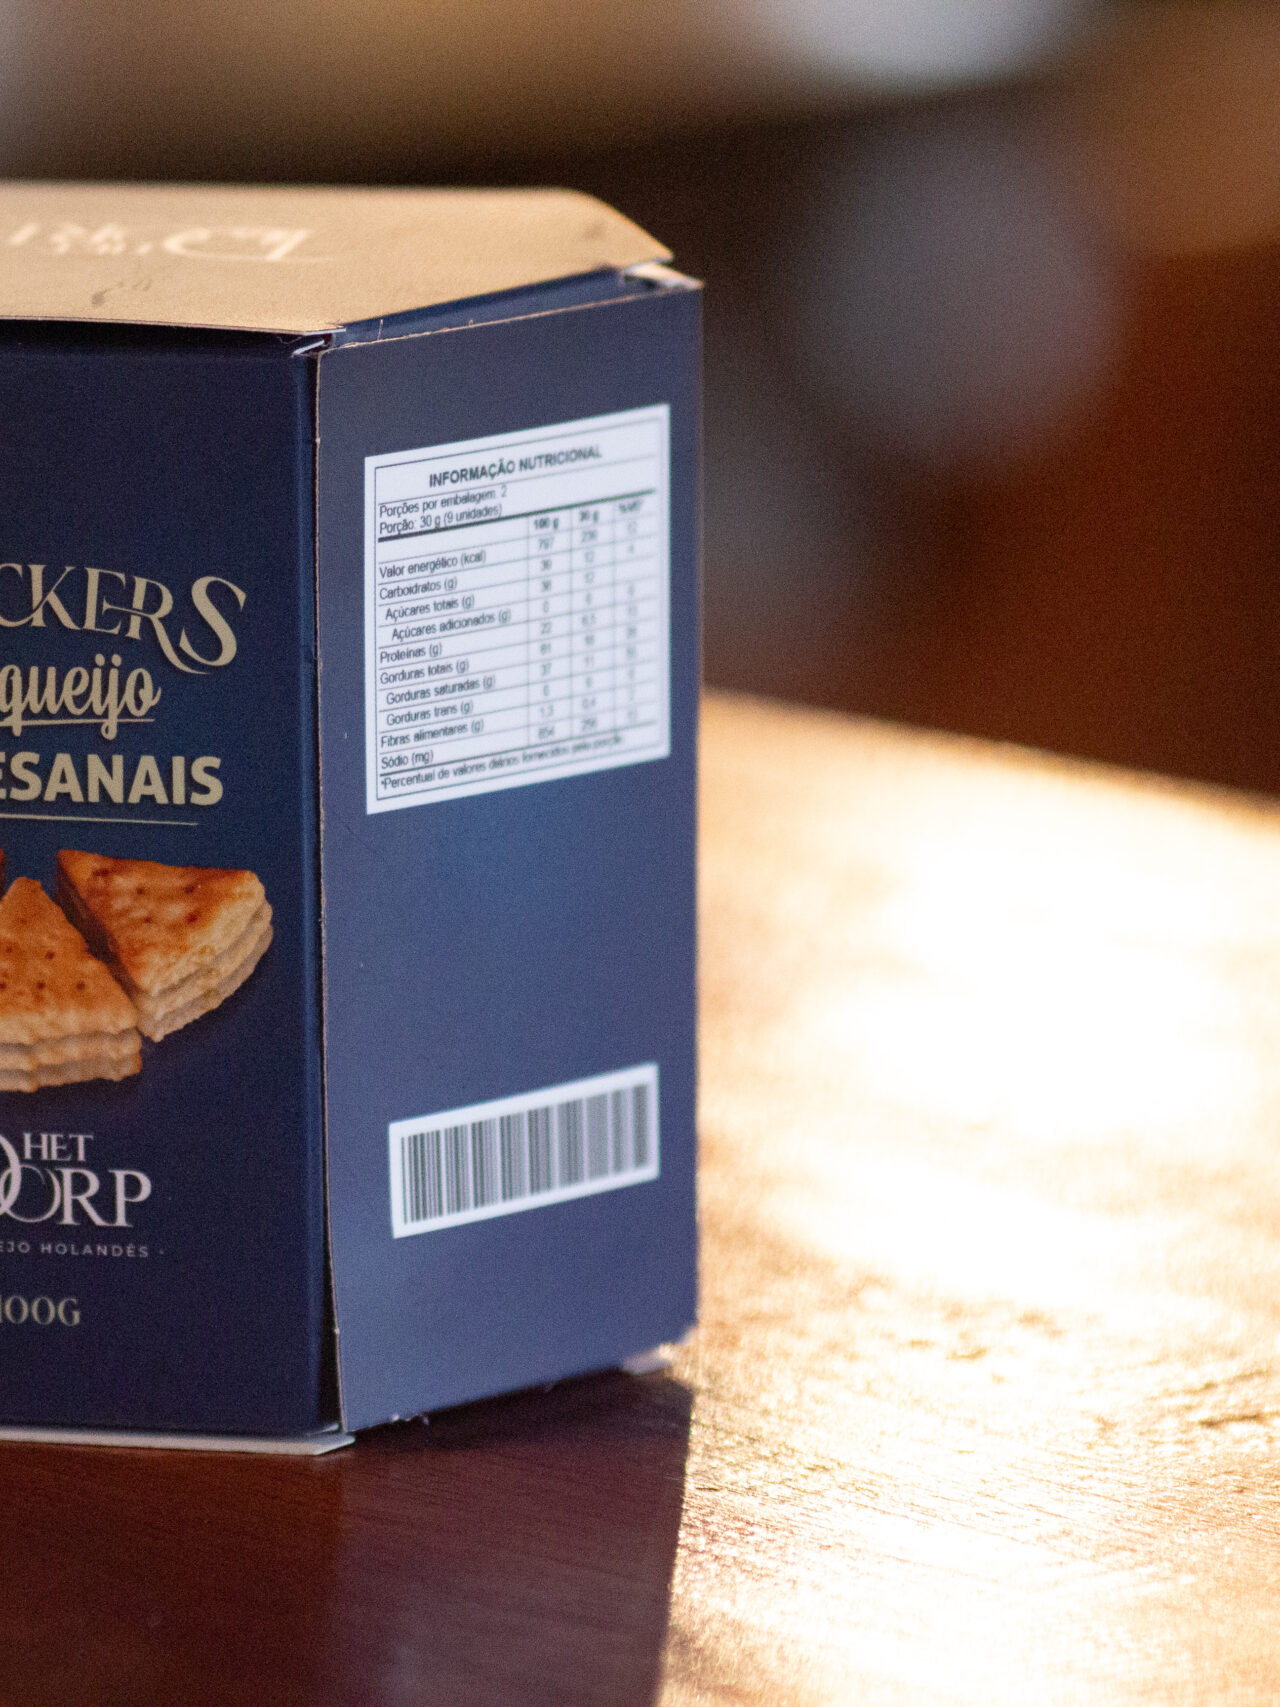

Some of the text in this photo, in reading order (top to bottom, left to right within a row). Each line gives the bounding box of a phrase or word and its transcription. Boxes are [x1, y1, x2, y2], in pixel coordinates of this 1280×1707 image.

[429, 444, 603, 488] INFORMAÇÃO NUTRICIONAL
[379, 501, 420, 519] Porções
[422, 499, 438, 513] por
[500, 484, 508, 498] 2
[420, 515, 432, 528] 30
[434, 516, 441, 529] g
[443, 511, 454, 527] (9
[455, 503, 503, 521] unidades)
[379, 564, 405, 579] Valor
[408, 555, 458, 576] energético
[460, 550, 487, 567] (kcal)
[379, 580, 442, 600] Carboidratos
[444, 576, 458, 592] (g)
[385, 600, 431, 621] Açúcares
[433, 595, 460, 614] totais
[462, 594, 475, 610] (g)
[392, 621, 437, 641] Açúcares
[439, 612, 496, 633] adicionados
[498, 608, 512, 625] (g)
[428, 642, 442, 658] (g)
[380, 663, 426, 684] Gorduras
[427, 660, 454, 678] totais
[456, 658, 470, 674] (g)
[386, 687, 431, 705] Gorduras
[434, 678, 480, 696] saturadas
[483, 674, 496, 690] (g)
[386, 708, 432, 726] Gorduras
[433, 703, 458, 719] trans
[460, 700, 474, 717] (g)
[381, 732, 411, 748] Fibras
[413, 724, 469, 743] alimentares
[471, 718, 485, 735] (g)
[381, 754, 409, 770] Sódio
[411, 749, 434, 766] (mg)
[437, 767, 450, 780] de
[452, 761, 487, 777] valores
[23, 1131, 94, 1161] HET
[40, 1240, 149, 1259] HOLANDÊS
